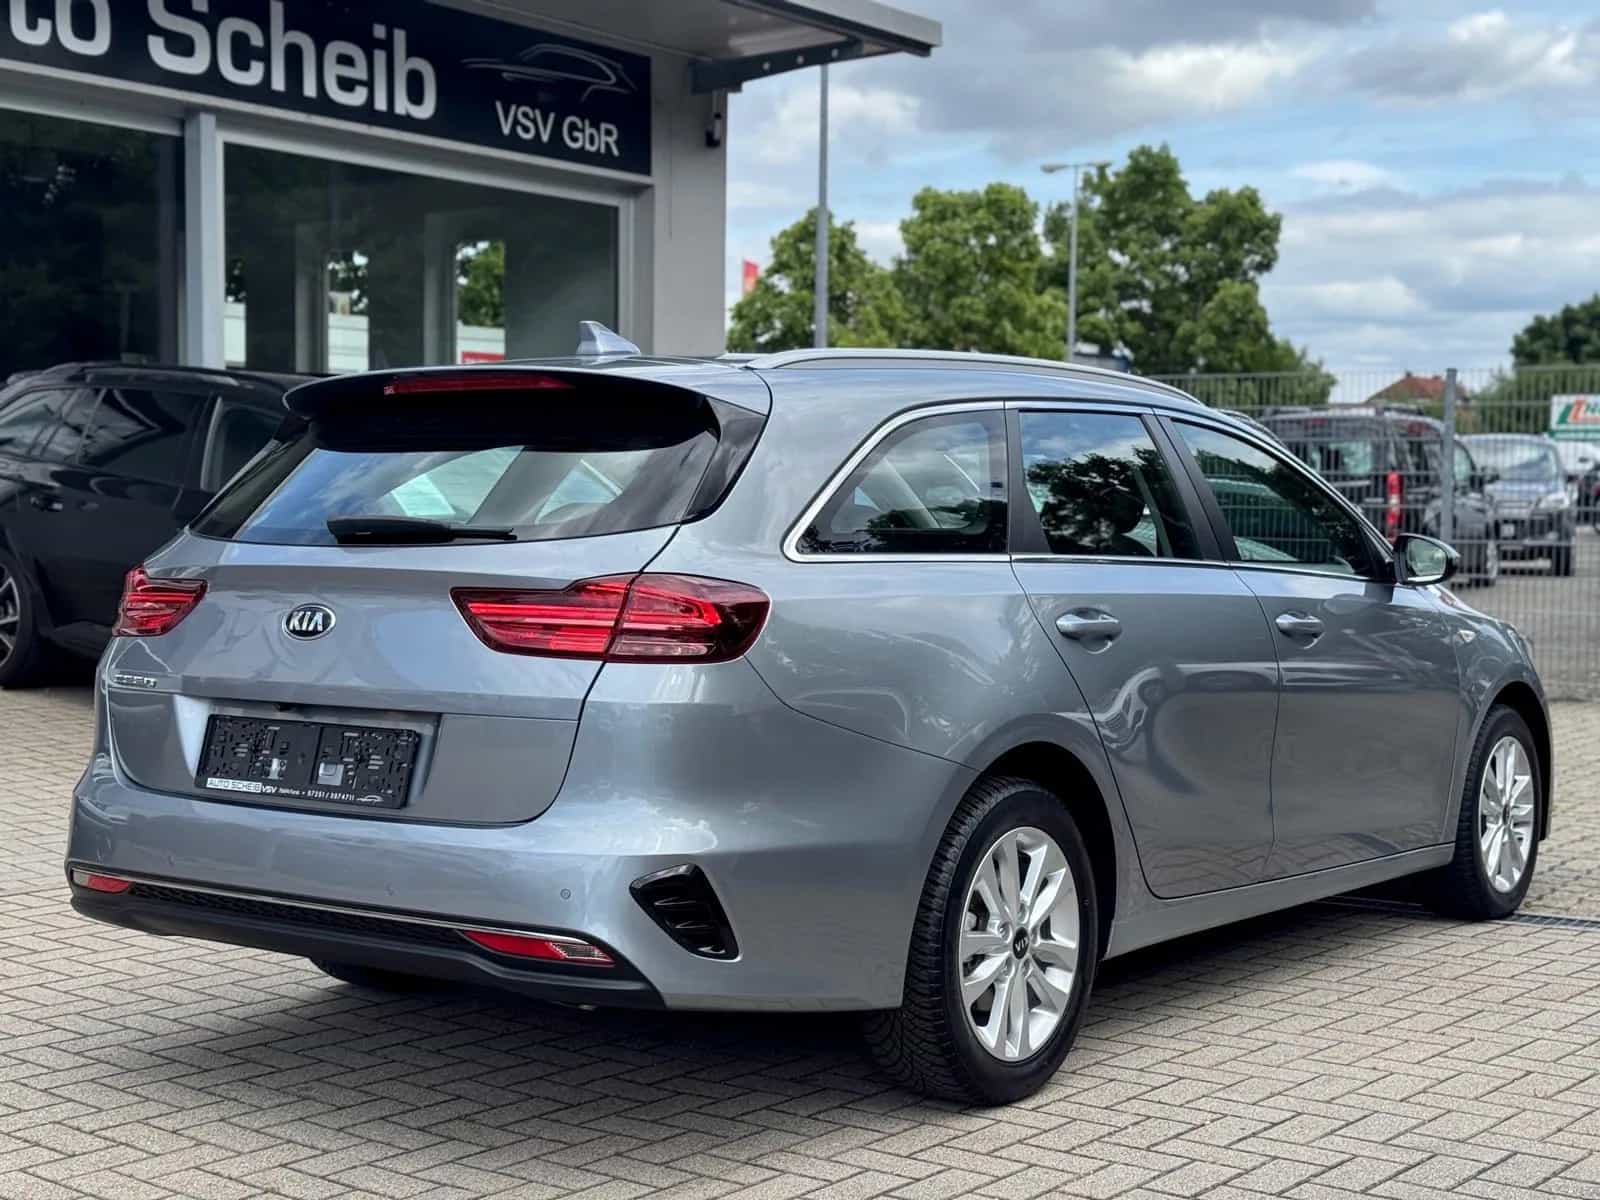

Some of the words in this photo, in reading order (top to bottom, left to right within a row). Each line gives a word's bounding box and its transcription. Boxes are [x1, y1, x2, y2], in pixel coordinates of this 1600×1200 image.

[147, 0, 437, 120] Scheib
[495, 100, 556, 143] VSV
[562, 115, 620, 157] GbR
[289, 611, 323, 631] KIA
